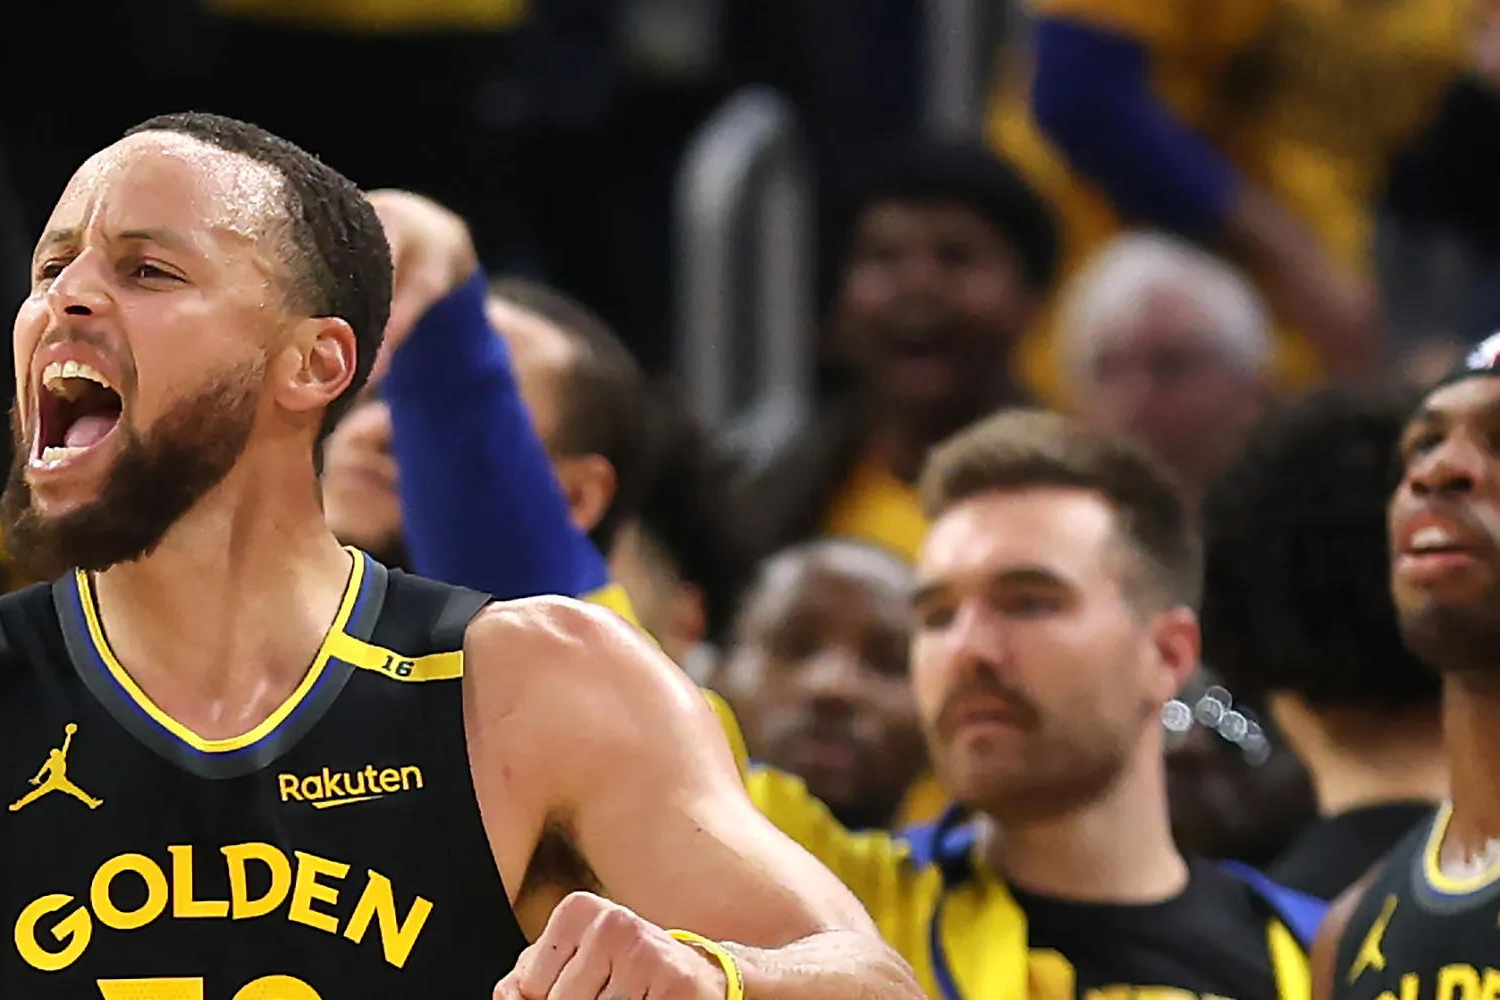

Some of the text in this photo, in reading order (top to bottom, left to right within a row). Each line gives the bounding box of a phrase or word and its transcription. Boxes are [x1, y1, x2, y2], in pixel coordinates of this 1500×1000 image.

[381, 654, 415, 677] 16
[277, 764, 424, 803] Rakuten
[14, 842, 434, 971] GOLDEN
